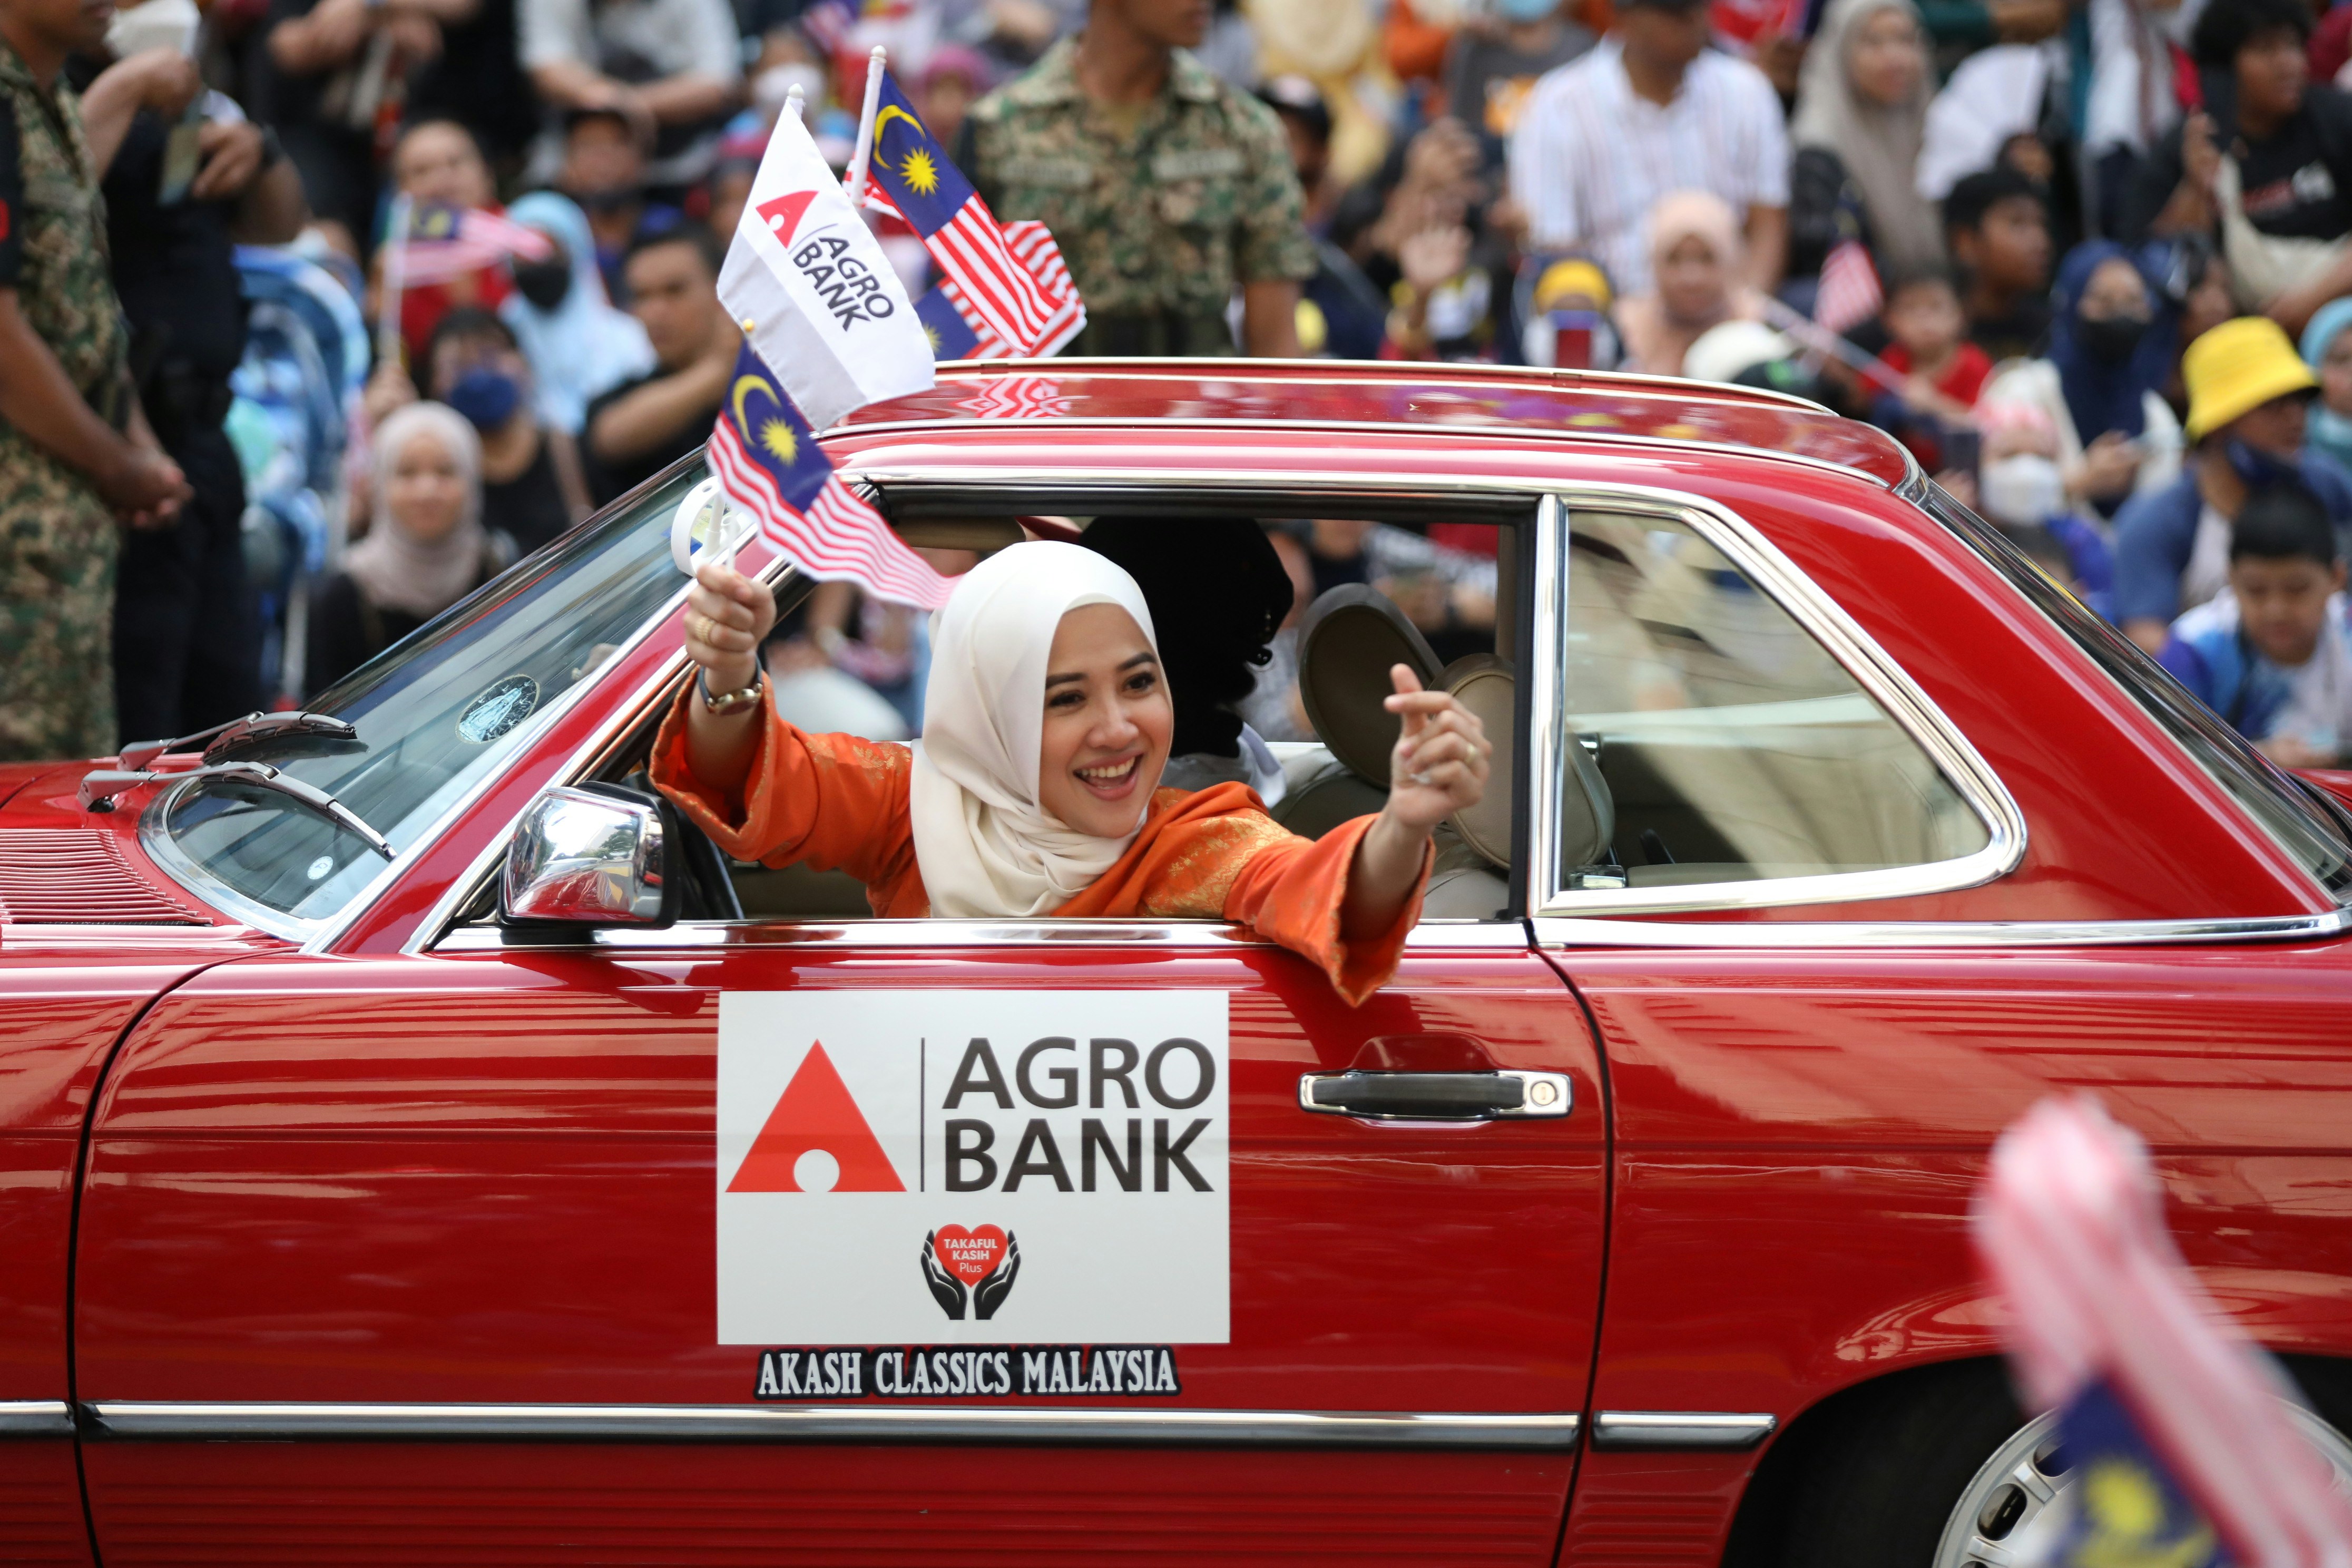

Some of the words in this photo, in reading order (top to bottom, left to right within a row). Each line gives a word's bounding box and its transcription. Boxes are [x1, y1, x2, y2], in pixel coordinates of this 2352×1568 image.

[792, 241, 871, 332] BANK
[817, 237, 895, 319] AGRO
[942, 1036, 1216, 1110] AGRO
[945, 1118, 1216, 1192] BANK
[943, 1238, 998, 1249] TAKAFUL
[952, 1250, 990, 1260] KASIH
[959, 1262, 983, 1273] Plus
[758, 1352, 863, 1395] AKASH
[875, 1351, 1011, 1395] CLASSICS
[1022, 1349, 1178, 1394] MALAYSIA
